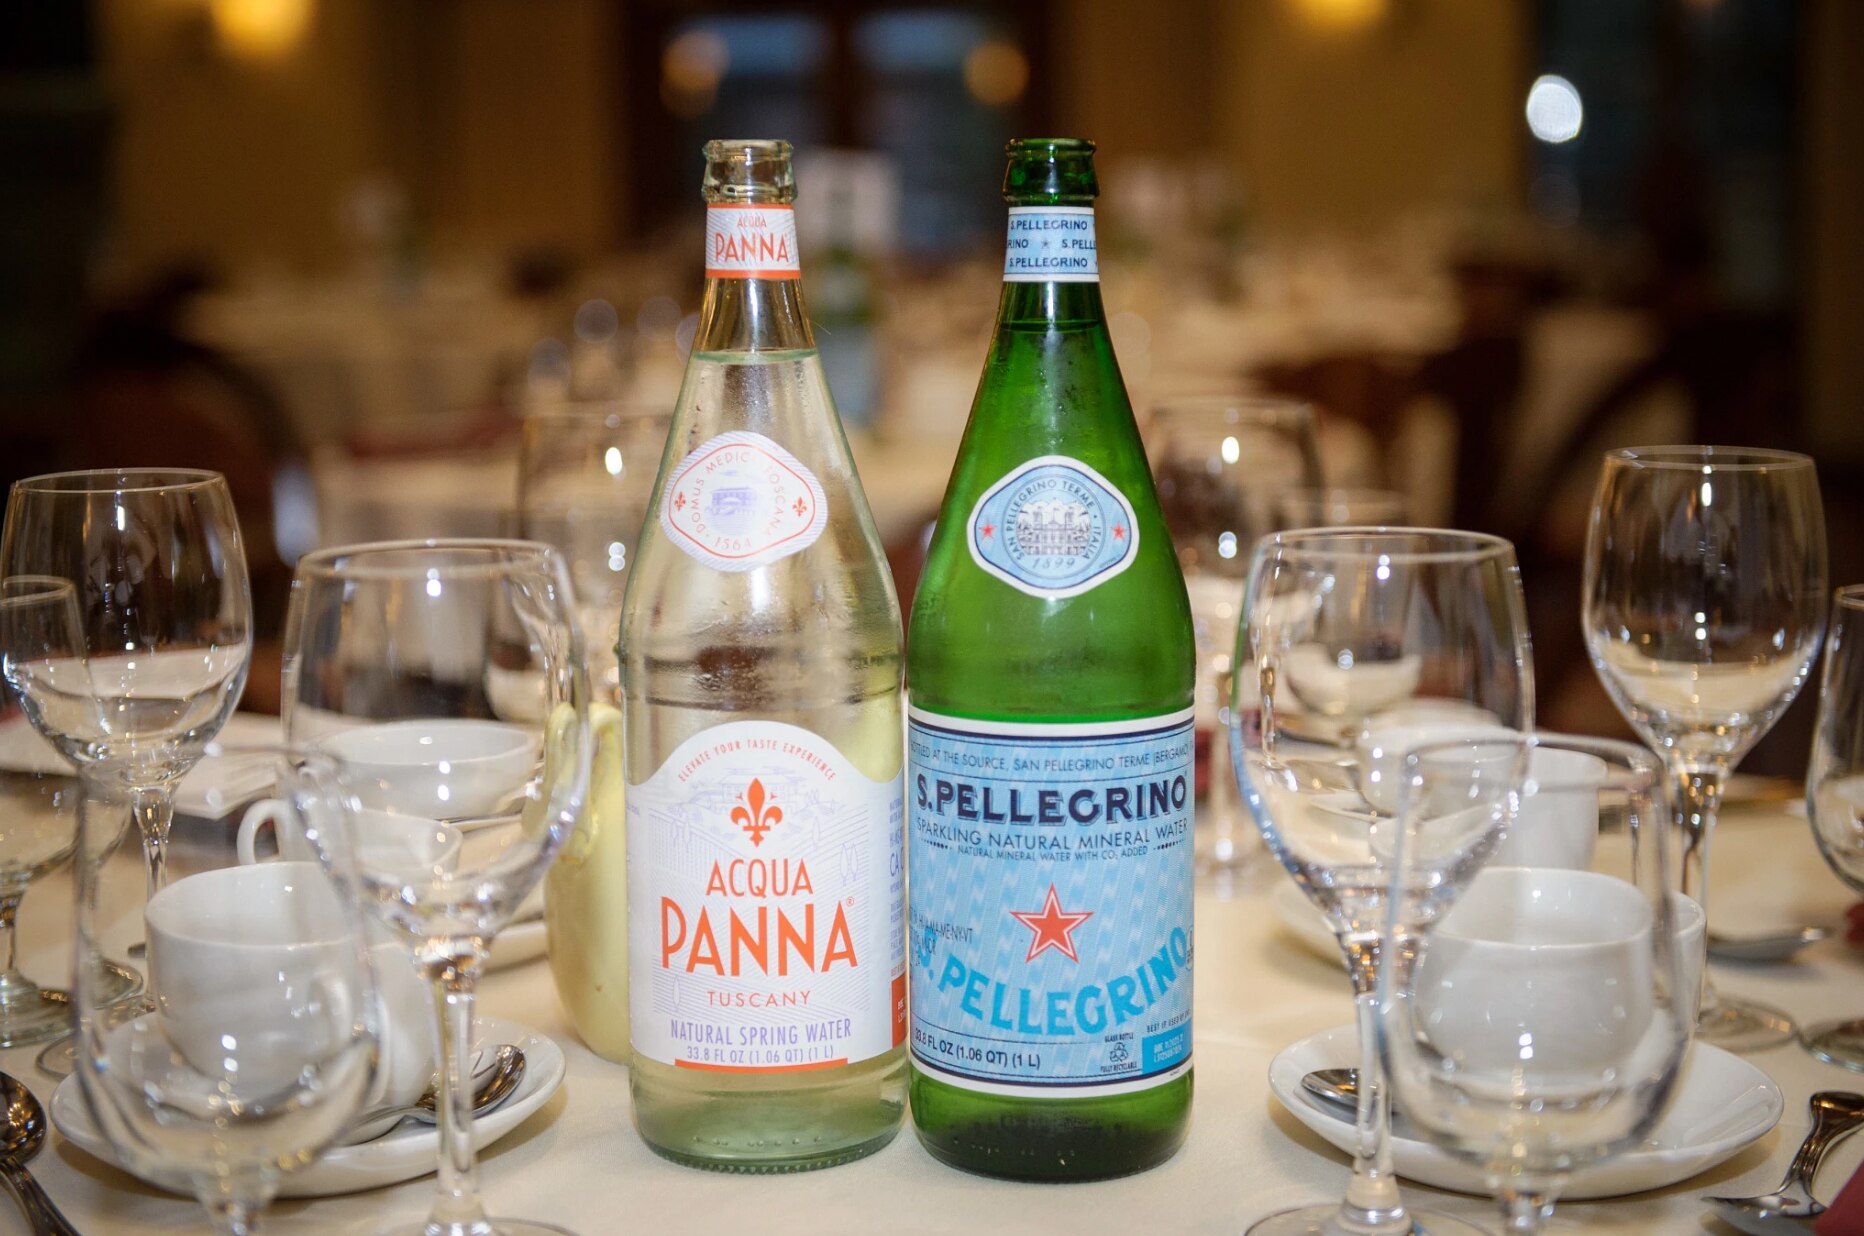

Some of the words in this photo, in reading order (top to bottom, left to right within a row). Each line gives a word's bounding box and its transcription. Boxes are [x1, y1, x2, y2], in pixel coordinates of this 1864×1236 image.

[736, 217, 767, 228] ACQUA
[715, 232, 789, 262] PANNA
[691, 477, 707, 534] DOMUS
[1006, 479, 1057, 532] PELLEGRINO
[1062, 480, 1095, 509] TERME
[1008, 538, 1025, 561] SAN
[1081, 526, 1101, 560] ITALIA
[1031, 557, 1076, 570] 1899
[678, 751, 711, 783] ELEVATE
[713, 740, 742, 756] YOUR
[747, 739, 778, 750] TASTE
[783, 742, 837, 781] EXPERIENCE
[932, 749, 941, 760] AT
[943, 750, 959, 764] THE
[962, 754, 1009, 771] SOURCE,
[1014, 758, 1040, 771] SAN
[1044, 757, 1116, 772] PELLEGRINO
[1119, 753, 1151, 768] TERME
[917, 817, 982, 846] SPARKLING
[988, 832, 1071, 850] NATURAL
[1079, 828, 1151, 849] MINERAL
[1155, 817, 1188, 840] WATER
[958, 844, 993, 860] NATURAL
[997, 851, 1036, 862] MINERAL
[1041, 851, 1071, 862] WATER
[1074, 850, 1098, 861] WITH
[1121, 844, 1148, 858] ADDED
[705, 858, 814, 898] ACQUA
[661, 896, 858, 977] PANNA
[707, 990, 811, 1008] TUSCANY
[671, 1019, 733, 1046] NATURAL
[739, 1025, 798, 1046] SPRING
[805, 1018, 851, 1043] WATER
[687, 1046, 710, 1061] 33.8
[714, 1050, 725, 1063] FL
[730, 1050, 744, 1064] OZ
[749, 1049, 780, 1065] (1.06
[784, 1048, 804, 1063] QT)
[808, 1046, 818, 1062] (1
[824, 1044, 834, 1060] L)
[928, 1034, 937, 1050] FL
[940, 1040, 954, 1055] OZ
[956, 1044, 982, 1061] (1.06
[986, 1050, 1008, 1068] QT)
[1012, 1053, 1023, 1068] (1
[1028, 1054, 1041, 1069] L)
